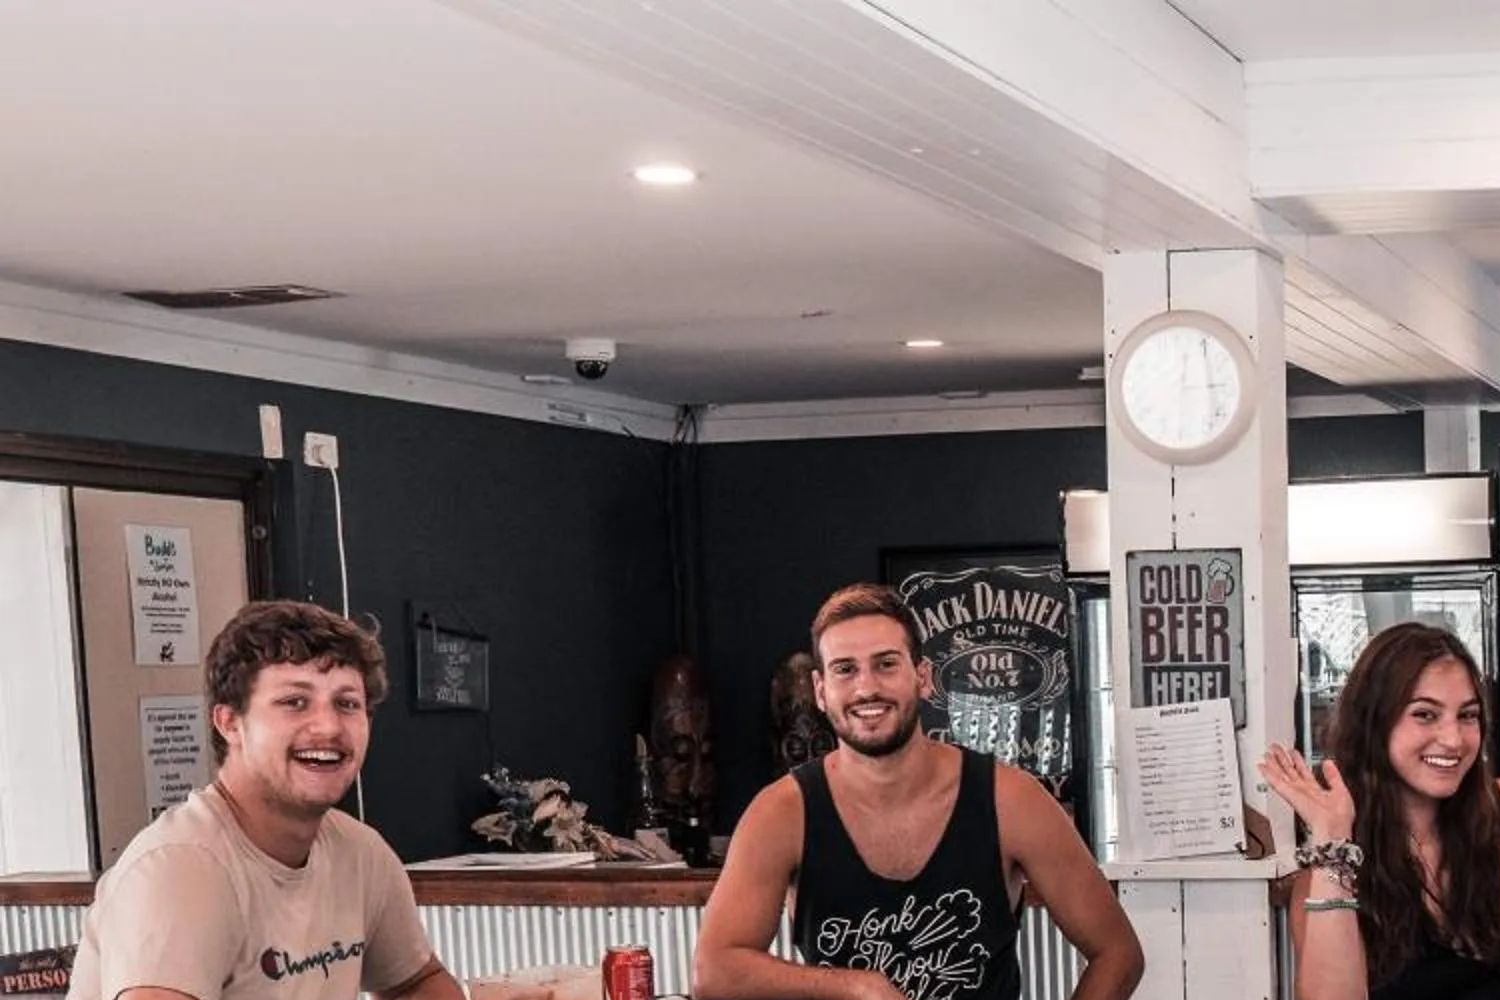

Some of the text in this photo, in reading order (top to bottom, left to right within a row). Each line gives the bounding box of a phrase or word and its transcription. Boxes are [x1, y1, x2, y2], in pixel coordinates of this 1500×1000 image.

[1139, 564, 1203, 605] COLD
[909, 593, 970, 645] JACK
[952, 622, 1033, 641] OLD TIME
[1140, 606, 1231, 664] BEER
[970, 651, 1015, 672] Old
[1151, 671, 1222, 708] HERE!
[817, 895, 933, 957] Honk
[3, 967, 70, 993] PERSO
